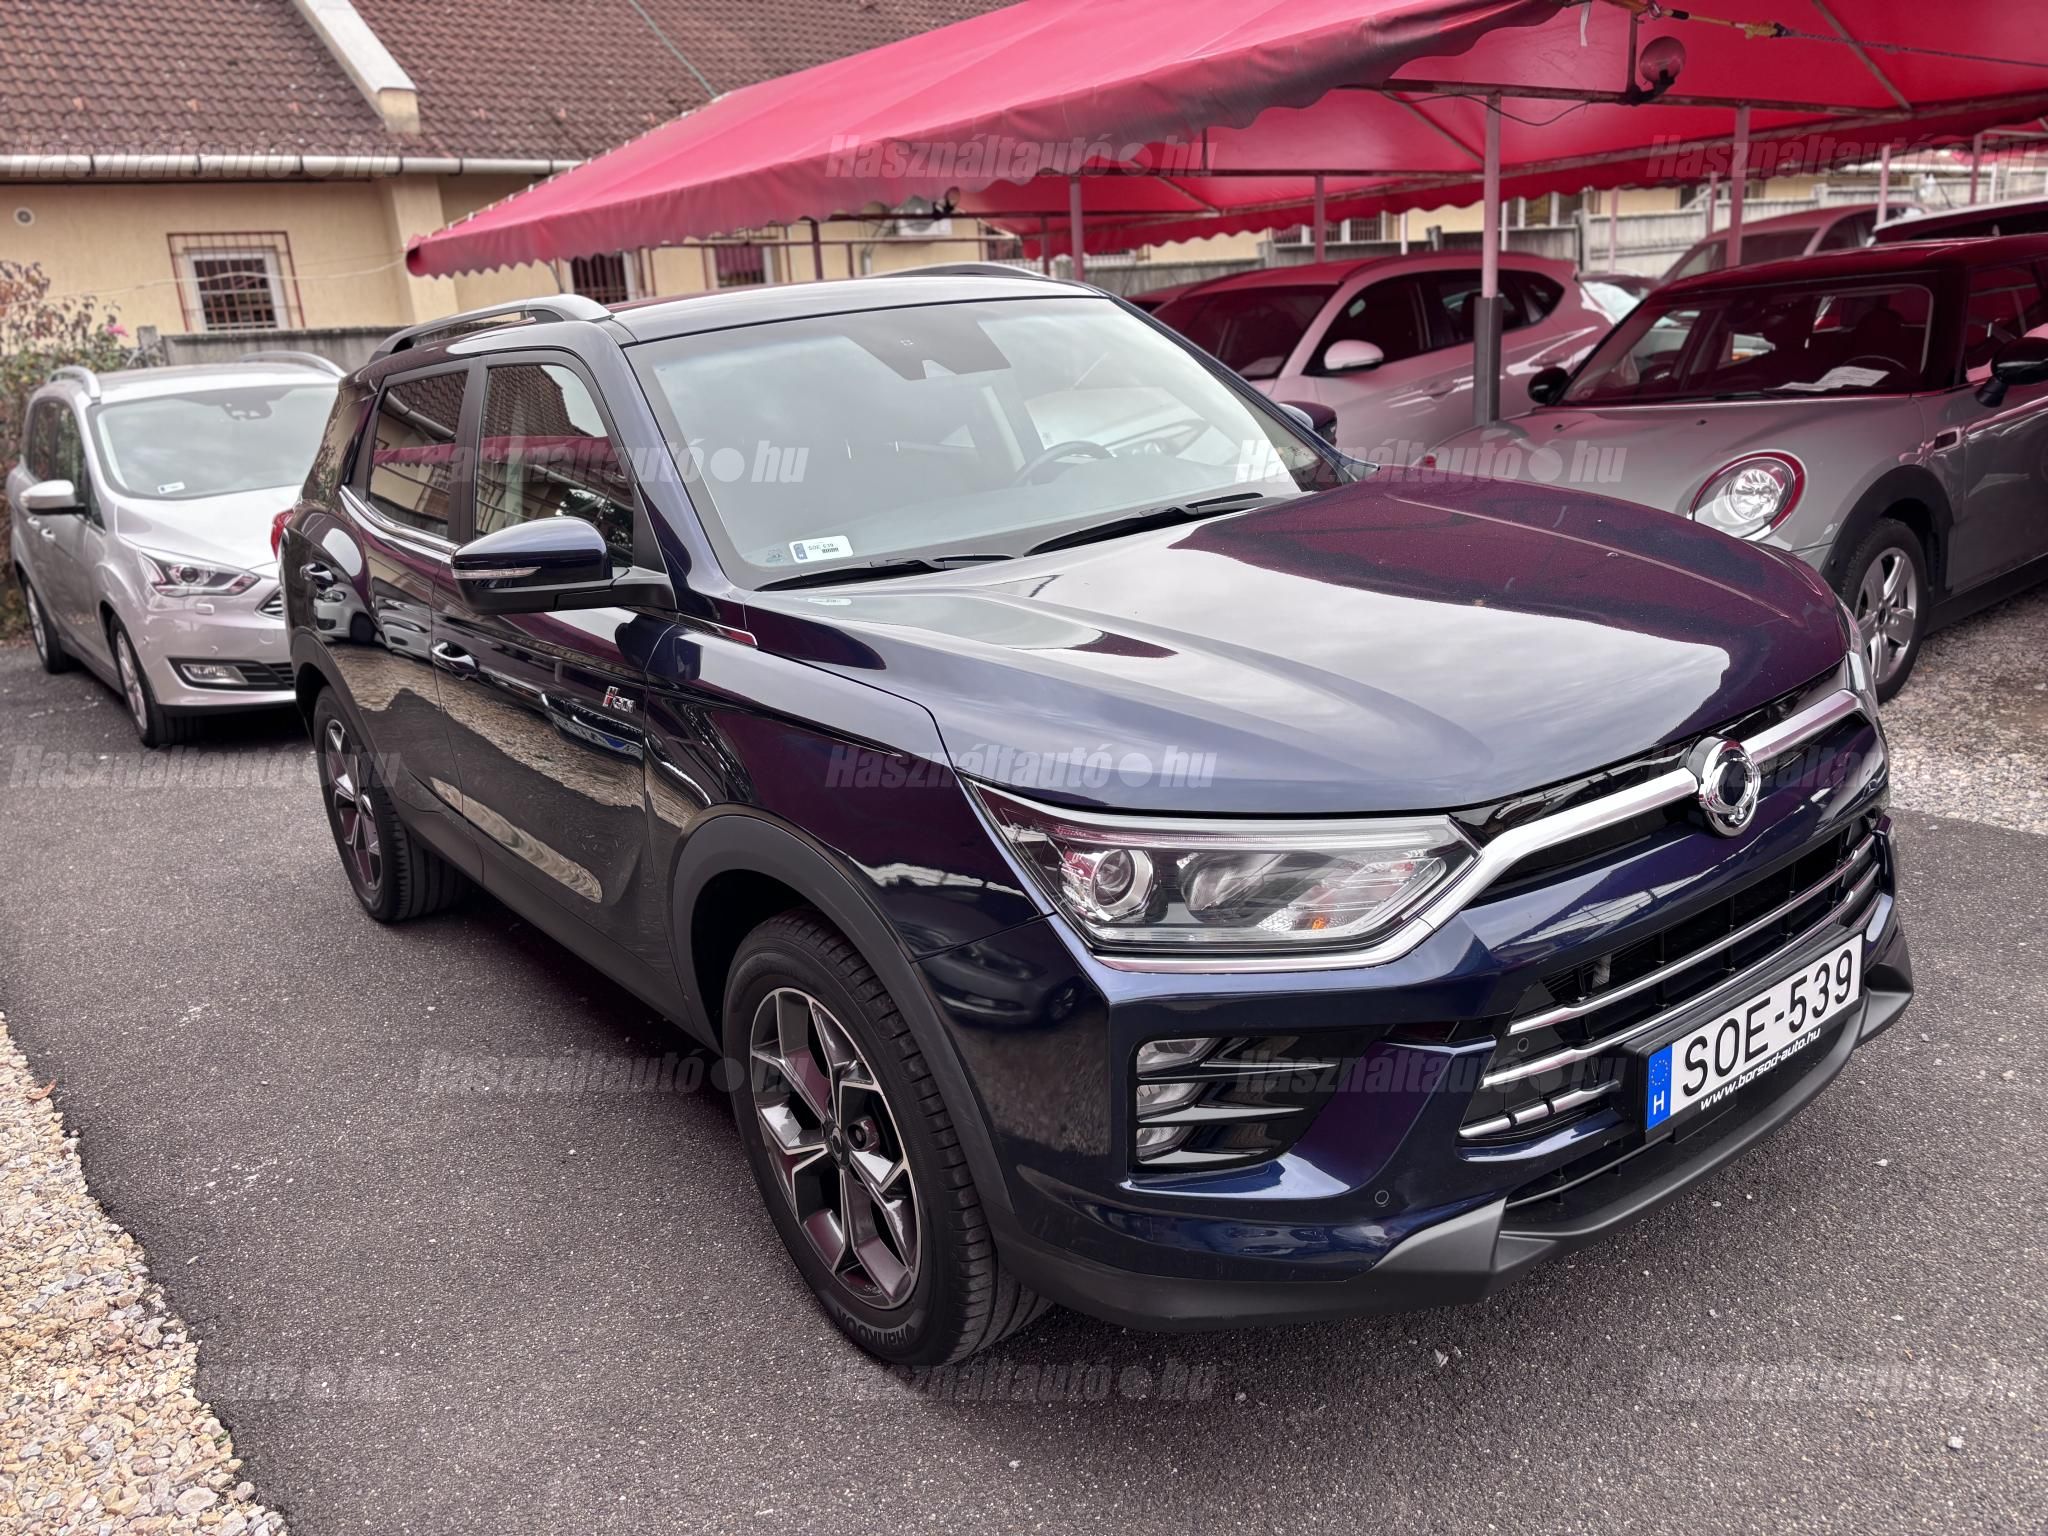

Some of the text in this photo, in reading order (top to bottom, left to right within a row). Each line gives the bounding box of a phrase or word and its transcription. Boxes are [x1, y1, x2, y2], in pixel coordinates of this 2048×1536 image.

[1682, 948, 1853, 1098] SOE-539
[1653, 1091, 1665, 1116] H
[1700, 1027, 1821, 1111] www.borsod-auto.hu
